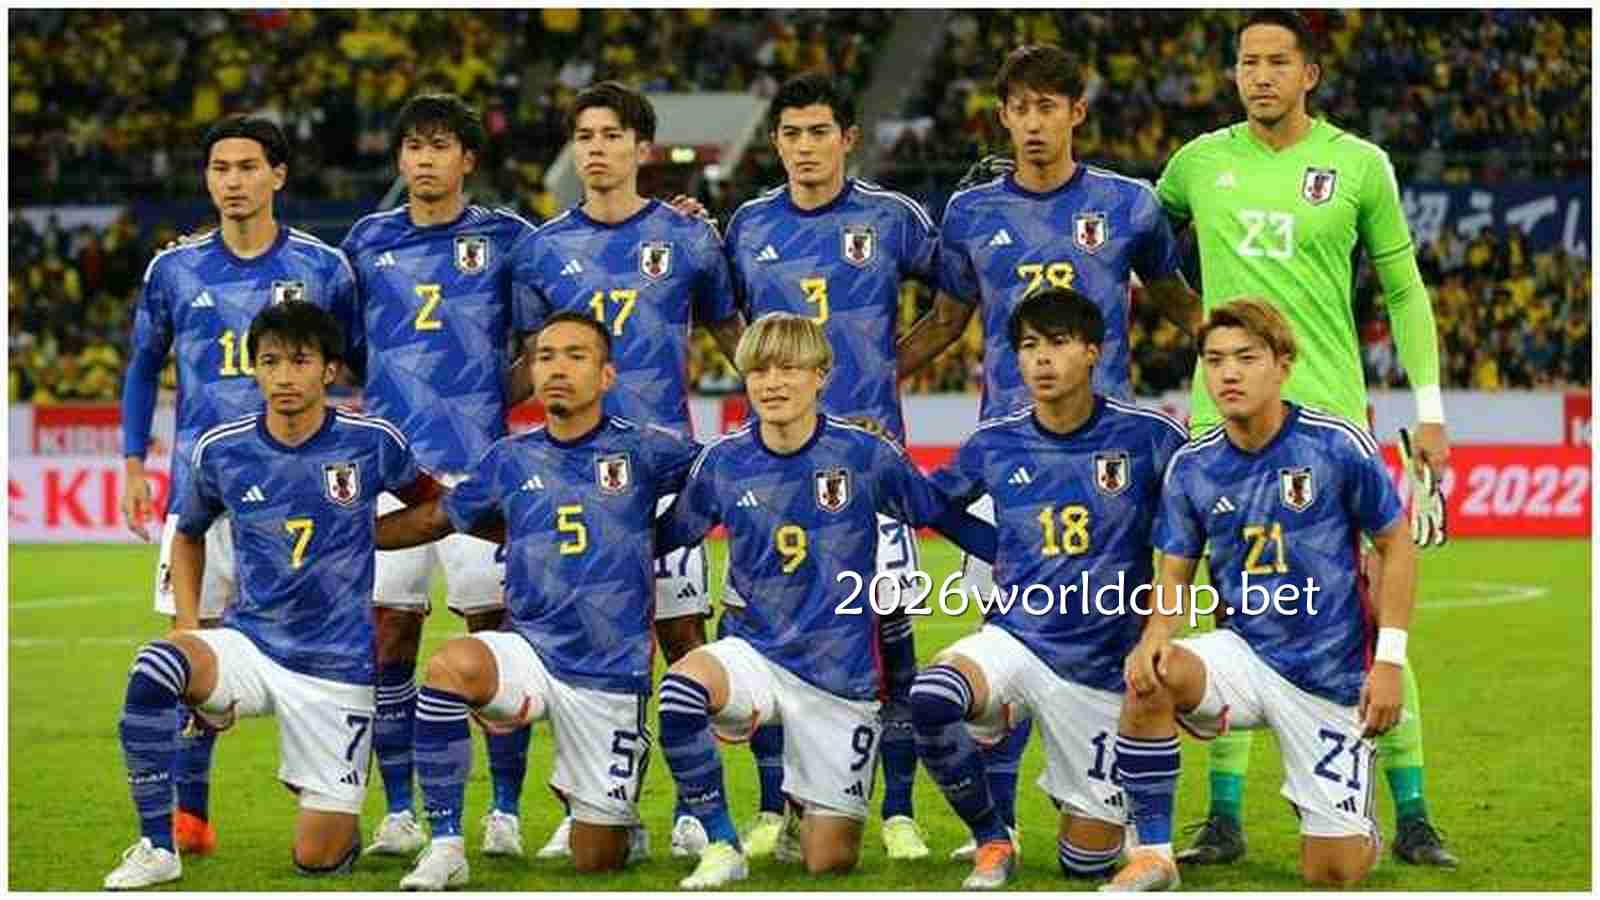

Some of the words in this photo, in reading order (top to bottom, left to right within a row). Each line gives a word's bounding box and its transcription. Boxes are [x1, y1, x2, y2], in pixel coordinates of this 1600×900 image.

[1238, 210, 1294, 258] 23
[415, 285, 443, 331] 2
[589, 289, 638, 337] 17
[800, 278, 829, 325] 3
[1461, 465, 1589, 518] 2022
[284, 518, 315, 568] 7
[556, 506, 589, 556] 5
[775, 524, 807, 574] 9
[1039, 506, 1091, 556] 18
[1242, 524, 1290, 576] 21
[344, 714, 369, 762] 7
[609, 729, 639, 779] 5
[850, 725, 874, 772] 9
[1314, 728, 1362, 791] 21
